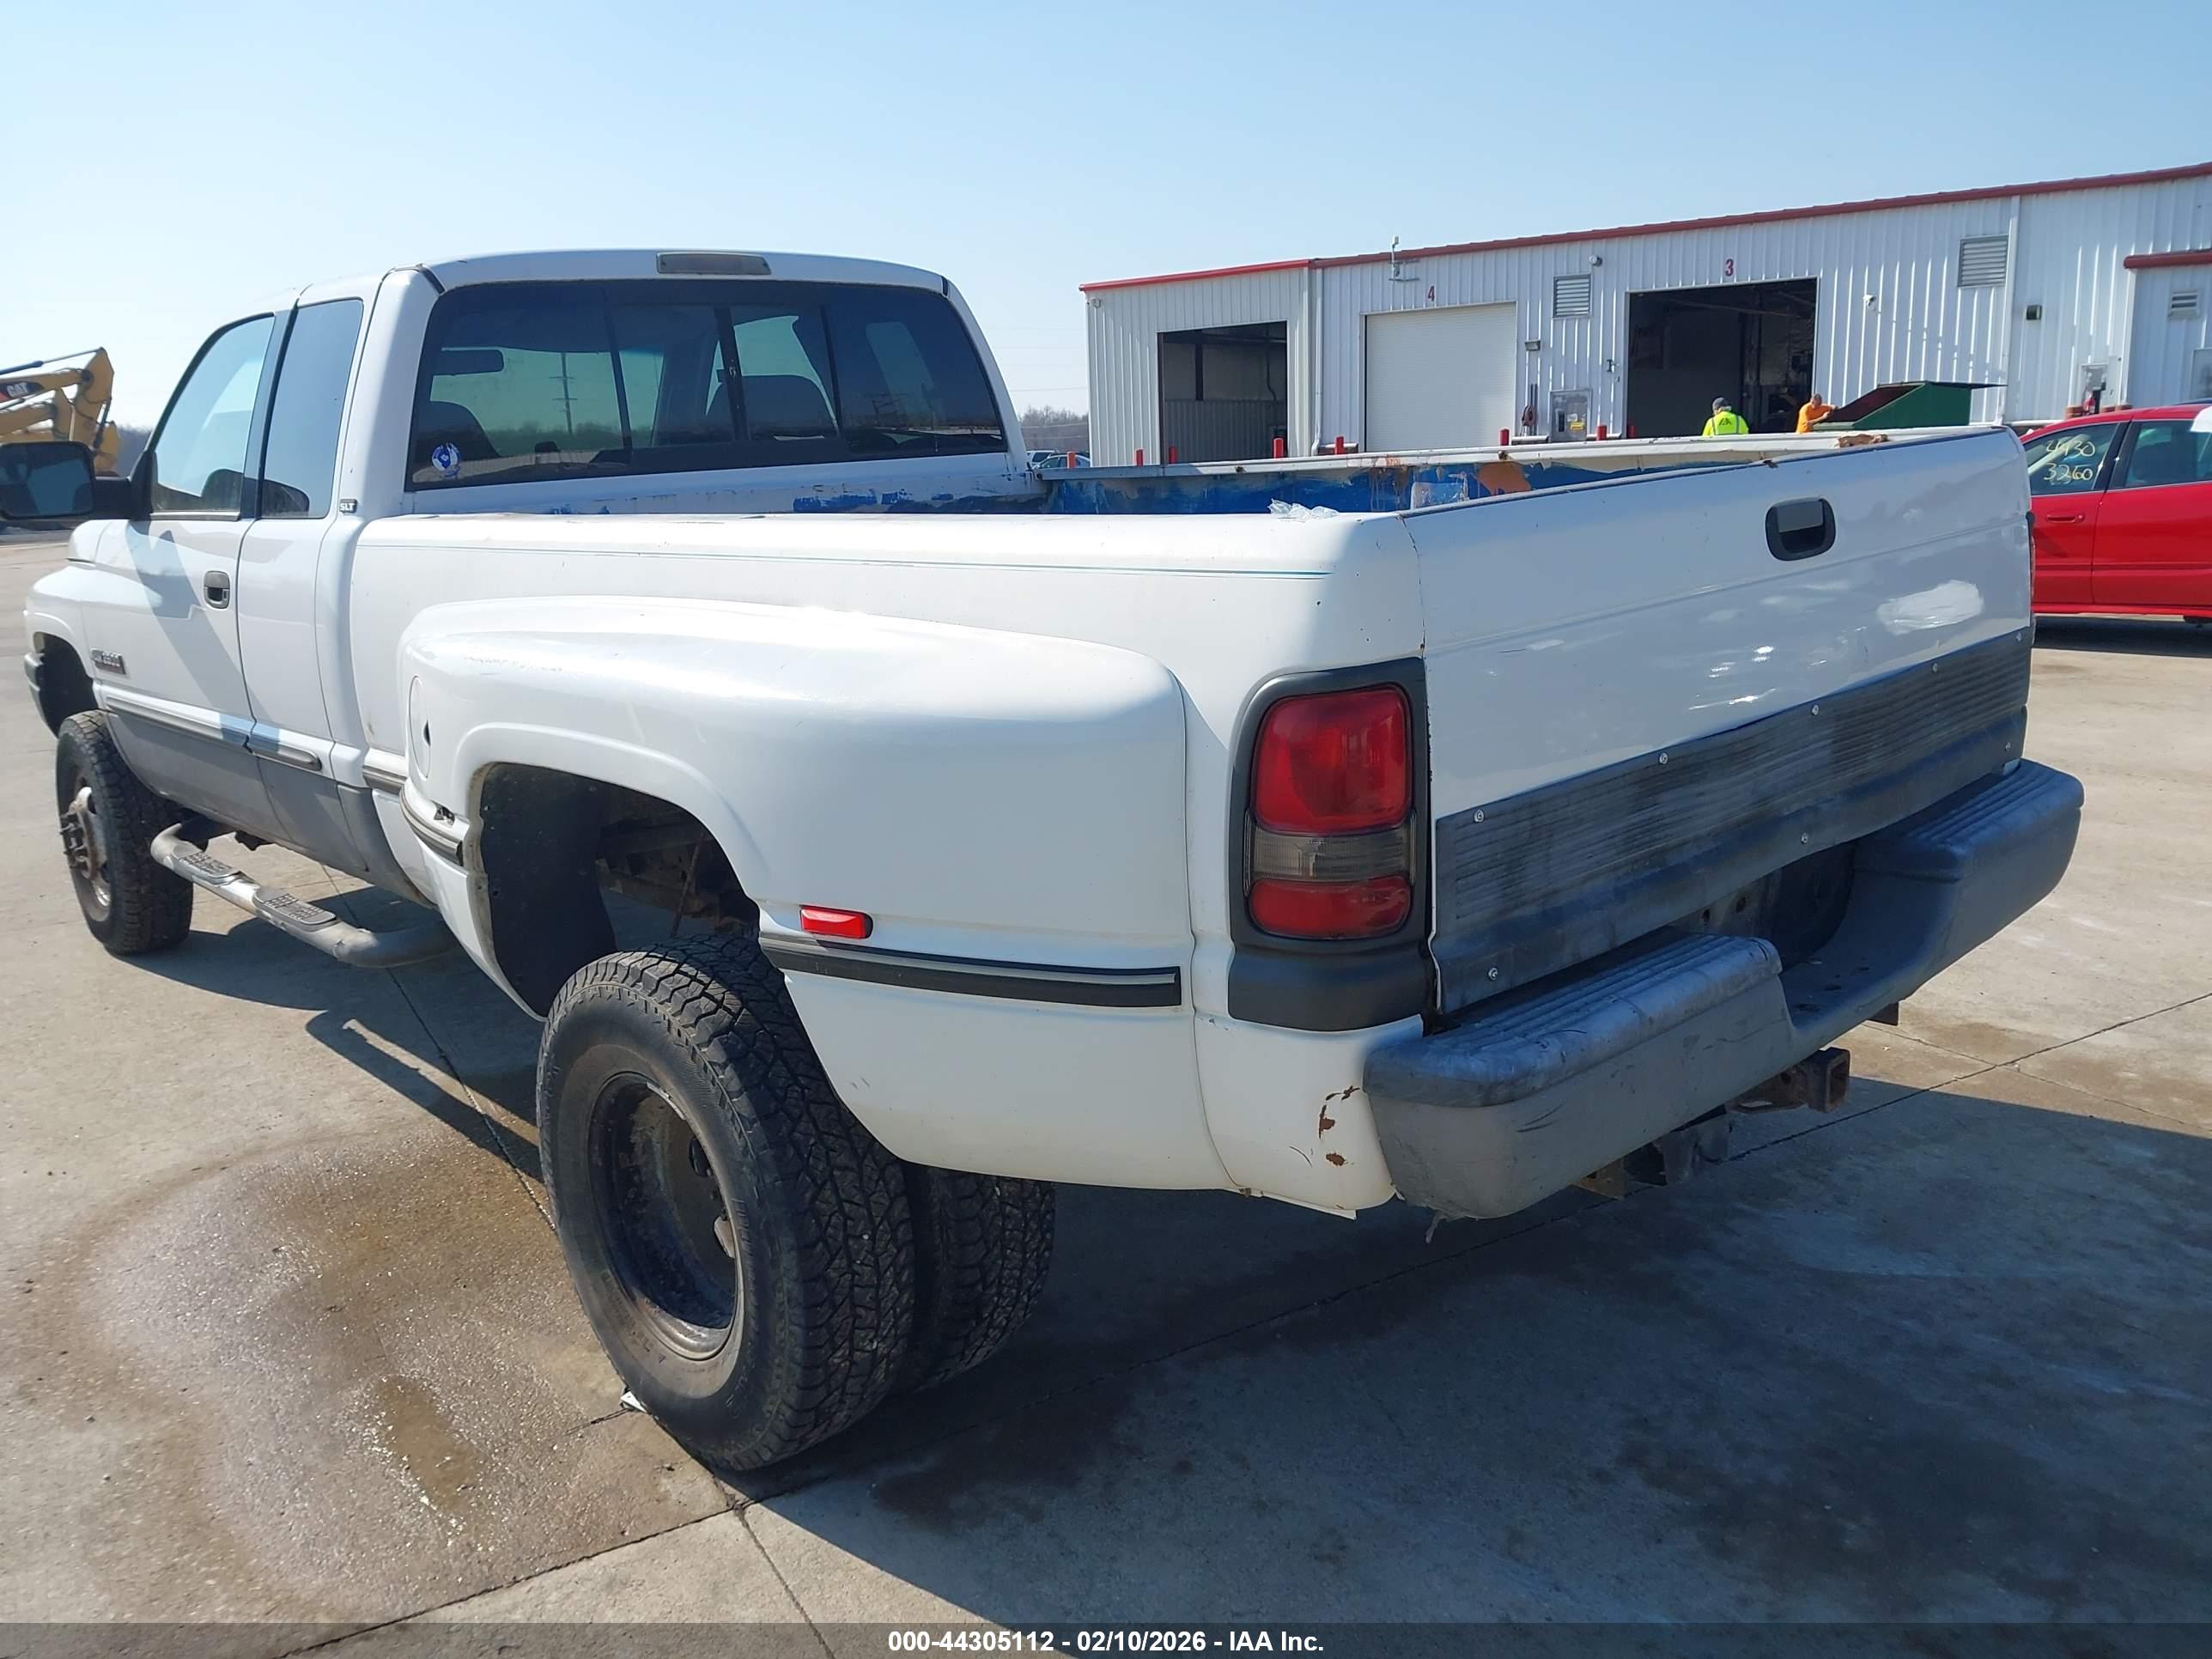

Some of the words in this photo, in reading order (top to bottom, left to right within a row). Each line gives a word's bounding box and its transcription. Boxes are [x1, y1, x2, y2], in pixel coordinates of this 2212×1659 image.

[1725, 258, 1734, 276] 3
[1427, 285, 1435, 301] 4
[6, 382, 28, 398] CAT
[339, 502, 356, 511] SLT
